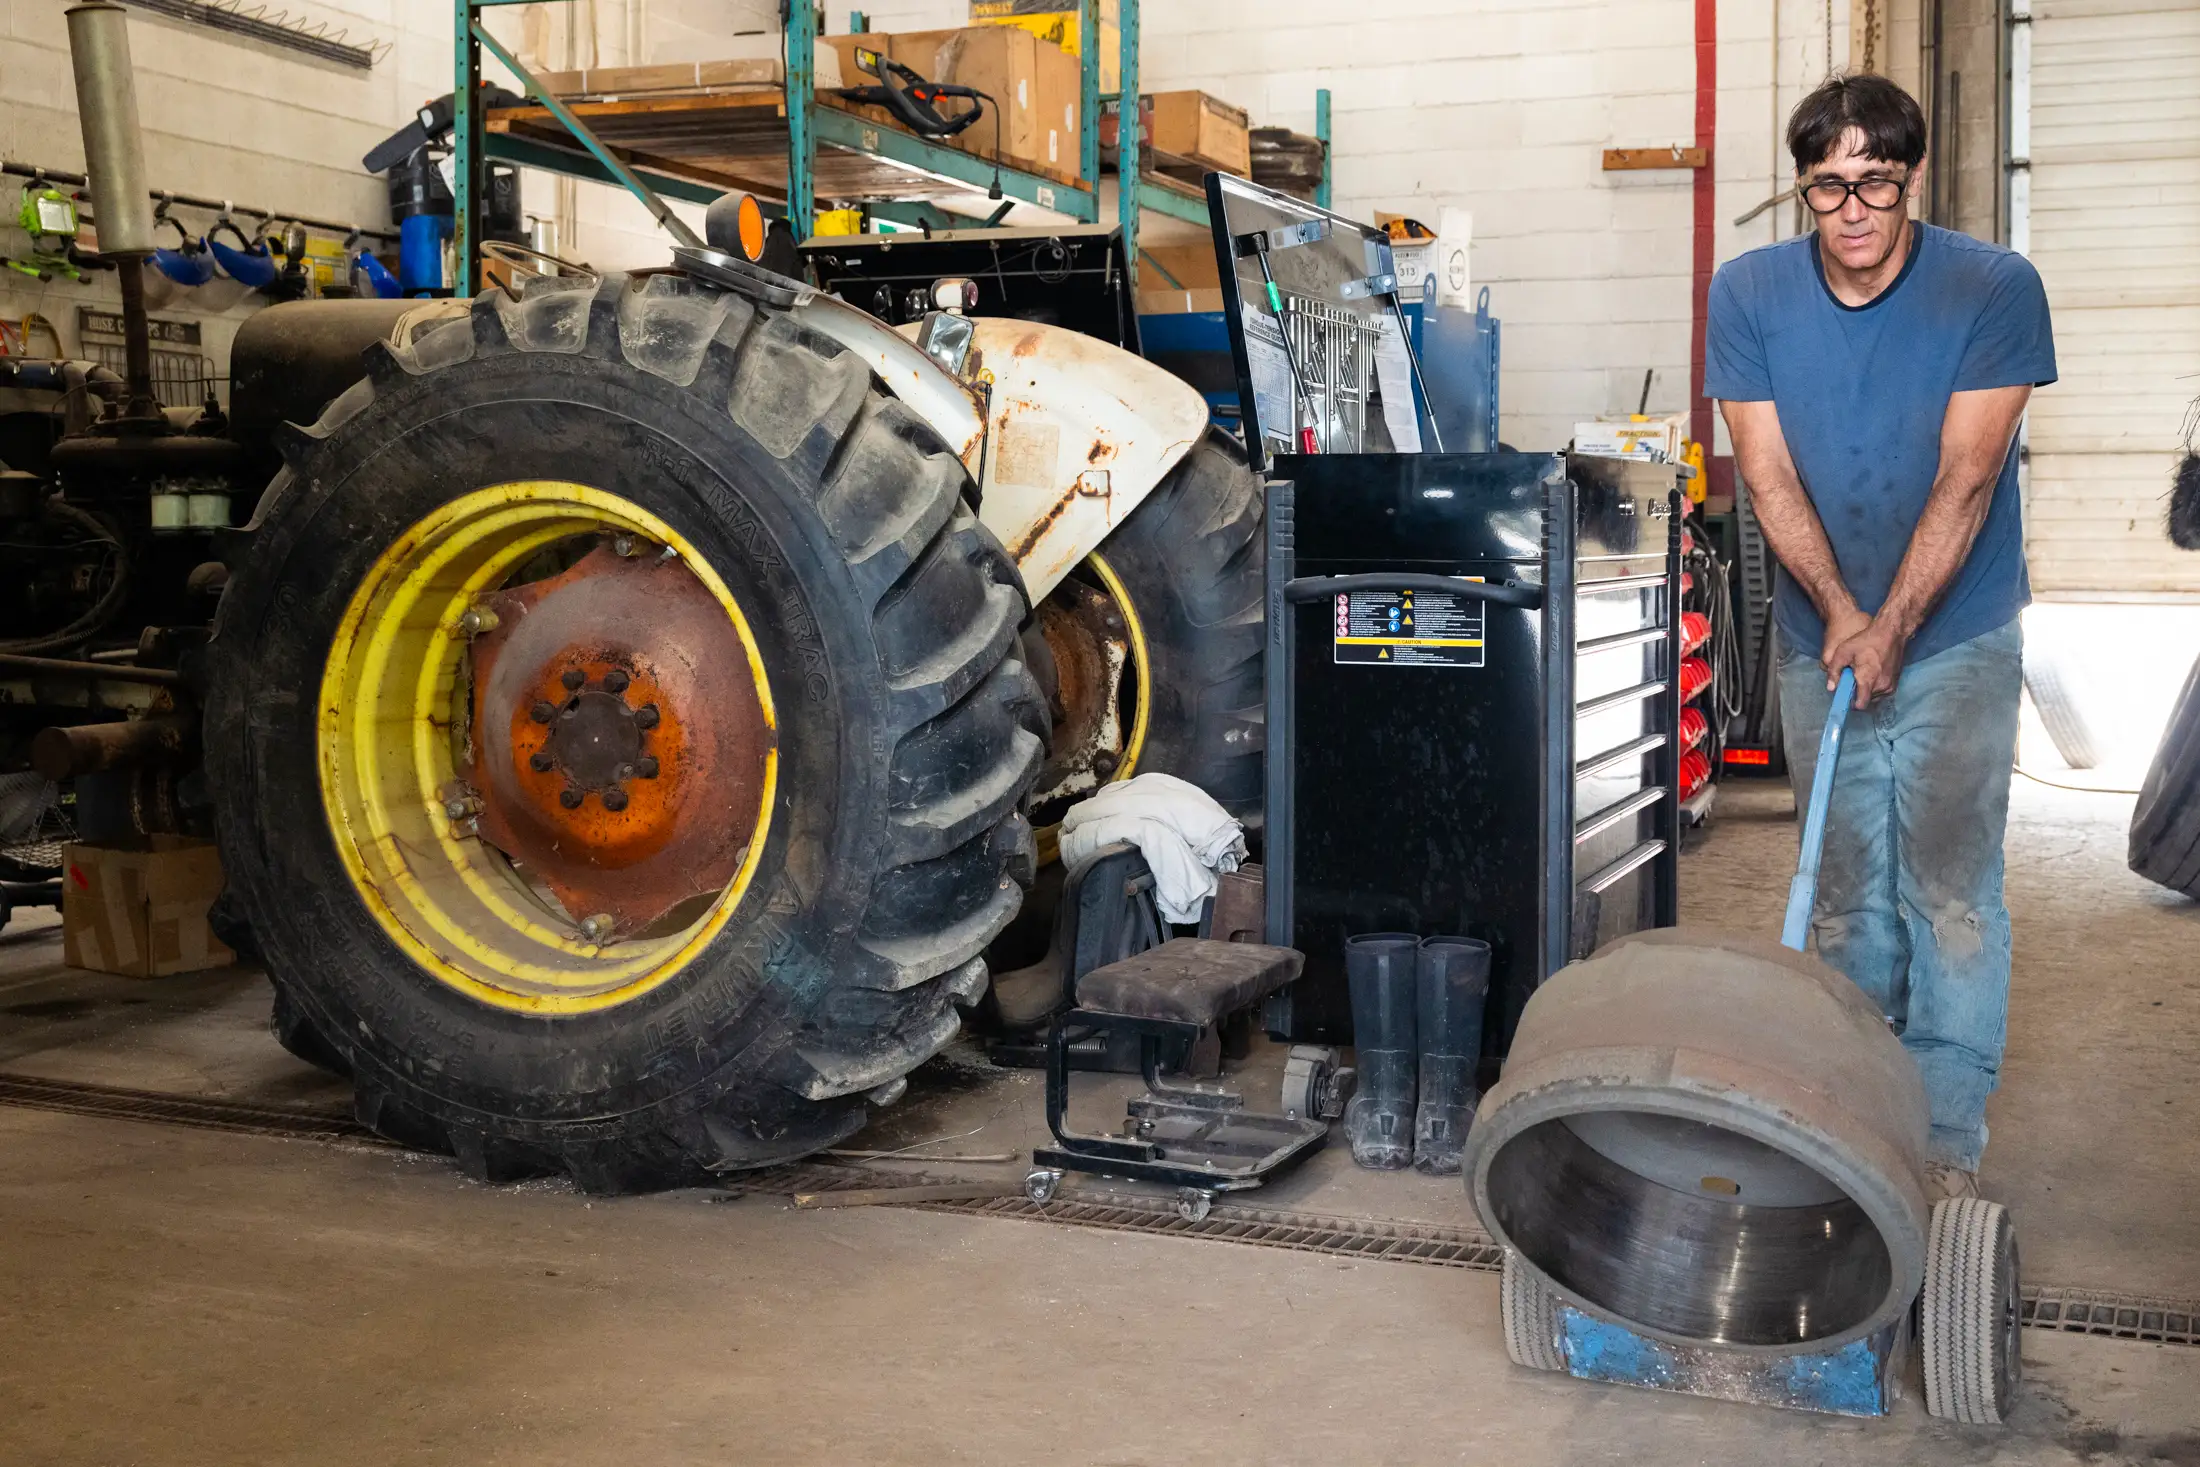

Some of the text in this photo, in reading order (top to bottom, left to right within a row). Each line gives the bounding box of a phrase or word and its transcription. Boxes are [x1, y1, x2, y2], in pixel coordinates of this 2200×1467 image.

[1399, 267, 1416, 277] 313
[641, 435, 692, 483] R-1
[707, 483, 782, 579] MAX
[780, 586, 828, 702] TRAC
